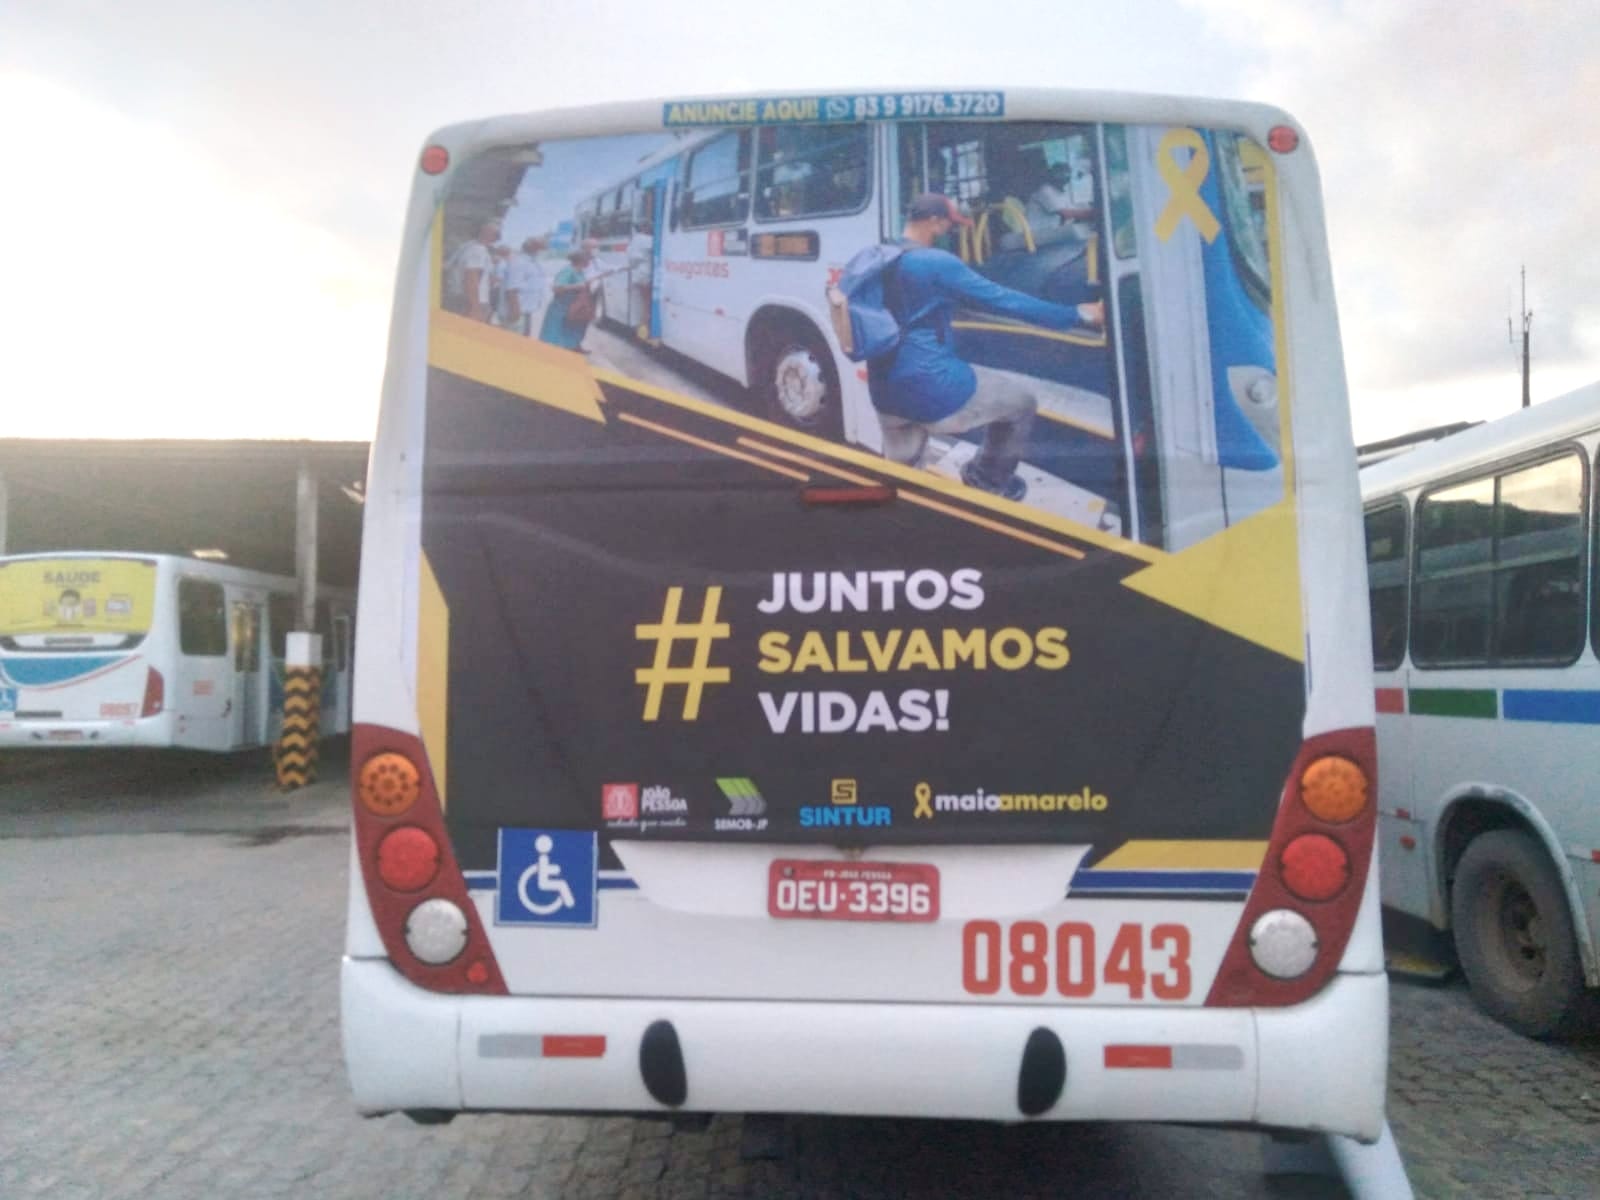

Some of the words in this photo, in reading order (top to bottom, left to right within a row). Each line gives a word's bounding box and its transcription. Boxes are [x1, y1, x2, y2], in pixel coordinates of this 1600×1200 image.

[668, 101, 758, 124] ANUNCIE
[854, 96, 879, 117] 83
[884, 96, 896, 115] 9
[901, 93, 1000, 115] 9176.3720
[757, 568, 985, 613] JUNTOS
[757, 627, 1070, 673] SALVAMOS
[757, 689, 950, 733] VIDAS!
[641, 798, 688, 812] PESSOA
[800, 807, 891, 827] SINTUR
[714, 818, 769, 831] SEMOB-JP
[962, 919, 1192, 1001] 08043
